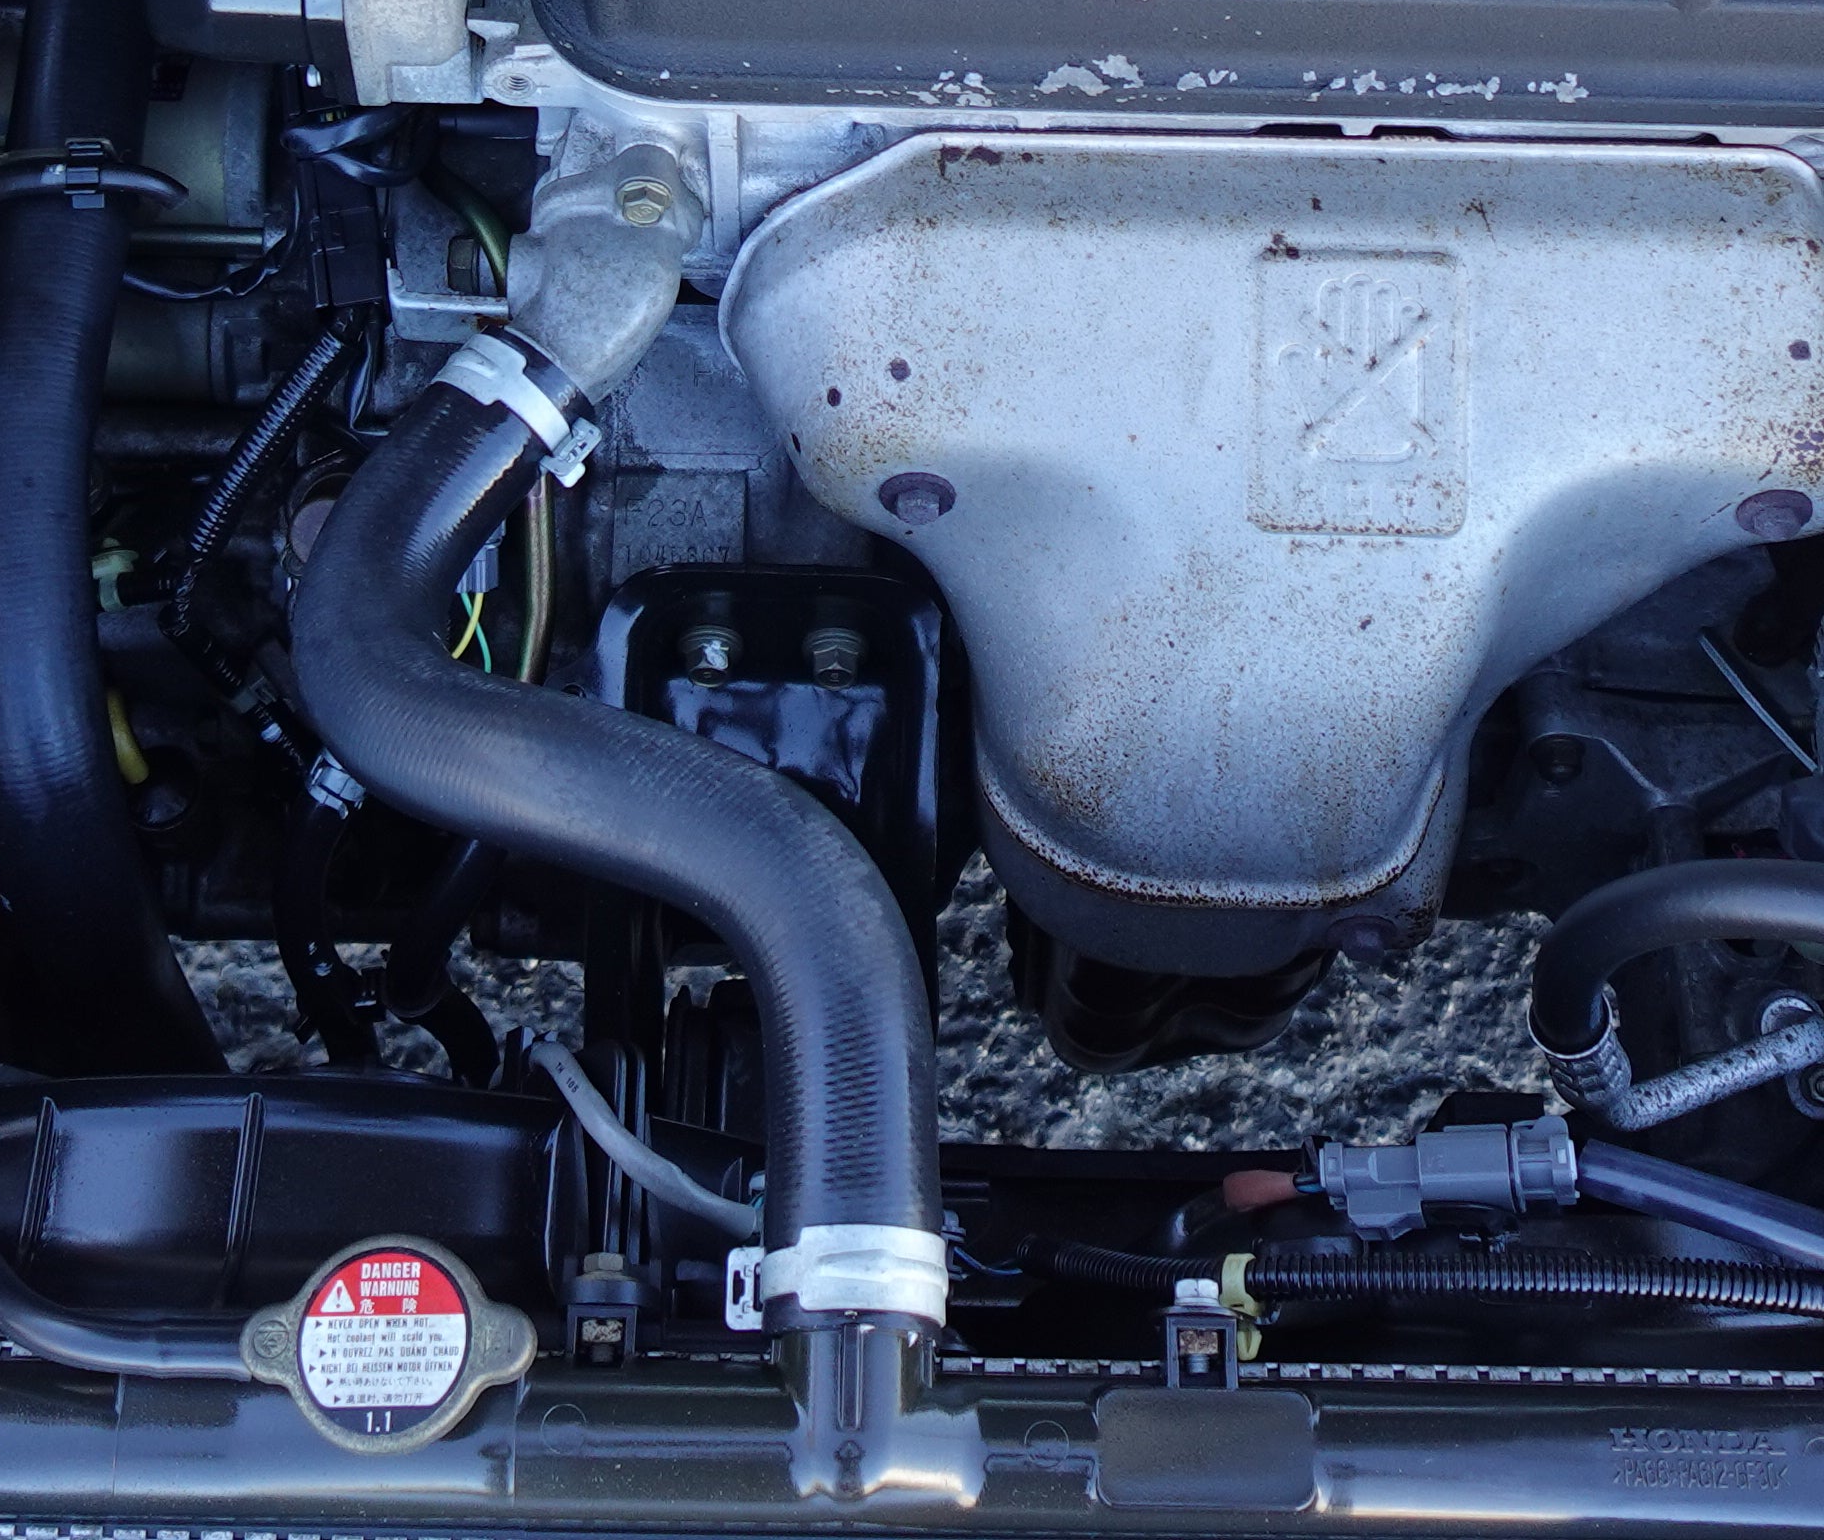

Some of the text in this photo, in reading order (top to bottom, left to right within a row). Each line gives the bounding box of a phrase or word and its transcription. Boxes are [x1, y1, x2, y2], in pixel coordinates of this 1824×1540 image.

[361, 1262, 421, 1279] DANGER
[360, 1280, 420, 1297] WARNUNG
[328, 1319, 353, 1329] NEVER
[359, 1318, 380, 1328] OPEN
[386, 1318, 408, 1328] WHEN
[327, 1333, 341, 1343] Hot
[346, 1333, 376, 1344] coolant
[381, 1332, 396, 1342] will
[402, 1332, 423, 1342] scald
[379, 1347, 394, 1357] PAS
[321, 1363, 342, 1373] NICHT
[346, 1362, 359, 1372] BEI
[362, 1362, 393, 1372] HEISSEM
[397, 1362, 421, 1372] MOTOR
[366, 1411, 392, 1433] 1.1
[1609, 1426, 1789, 1457] HONDA
